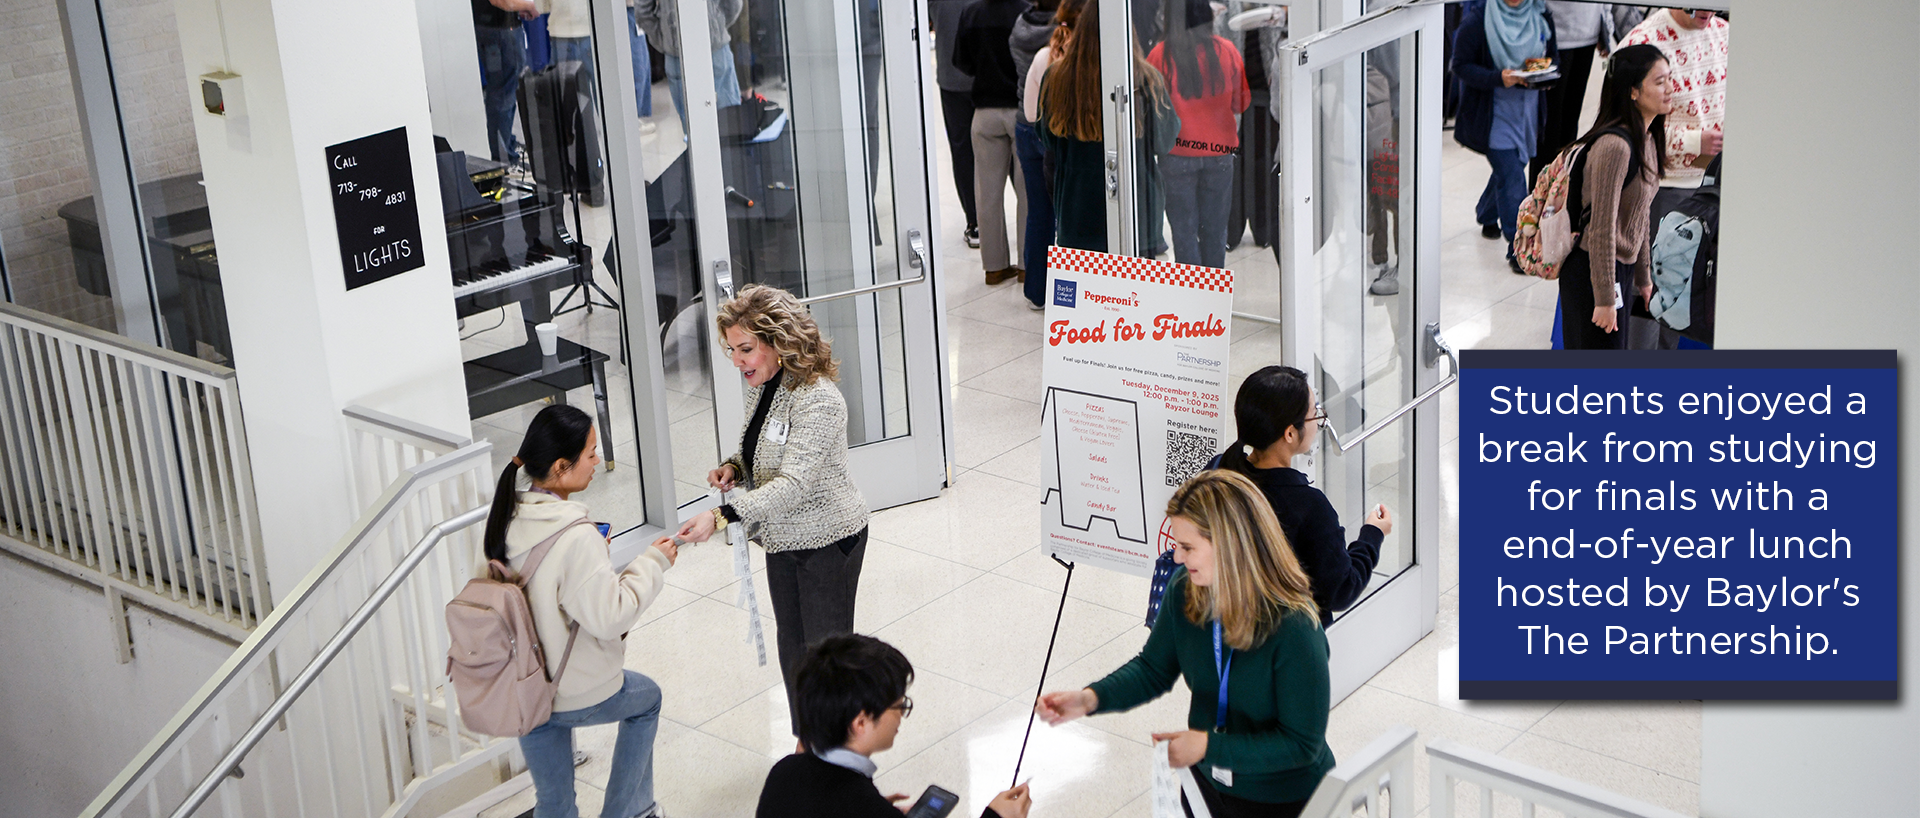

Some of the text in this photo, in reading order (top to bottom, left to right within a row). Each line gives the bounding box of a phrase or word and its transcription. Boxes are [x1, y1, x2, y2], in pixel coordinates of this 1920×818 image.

[1176, 138, 1208, 150] RAYZOR
[1382, 138, 1398, 149] For
[338, 181, 406, 206] 713- 798- 4831
[1372, 186, 1399, 198] #8-48
[354, 239, 411, 273] LIGHTS
[1049, 313, 1226, 346] Food for Finals
[1122, 379, 1219, 402] Tuesday, December 9, 2025
[1143, 391, 1162, 400] 12:00
[1165, 402, 1218, 418] Rayzor Lounge
[1167, 419, 1218, 434] Register here:
[1088, 453, 1107, 463] Salads
[1090, 473, 1109, 483] Drinks
[1087, 500, 1117, 512] Candy Bar
